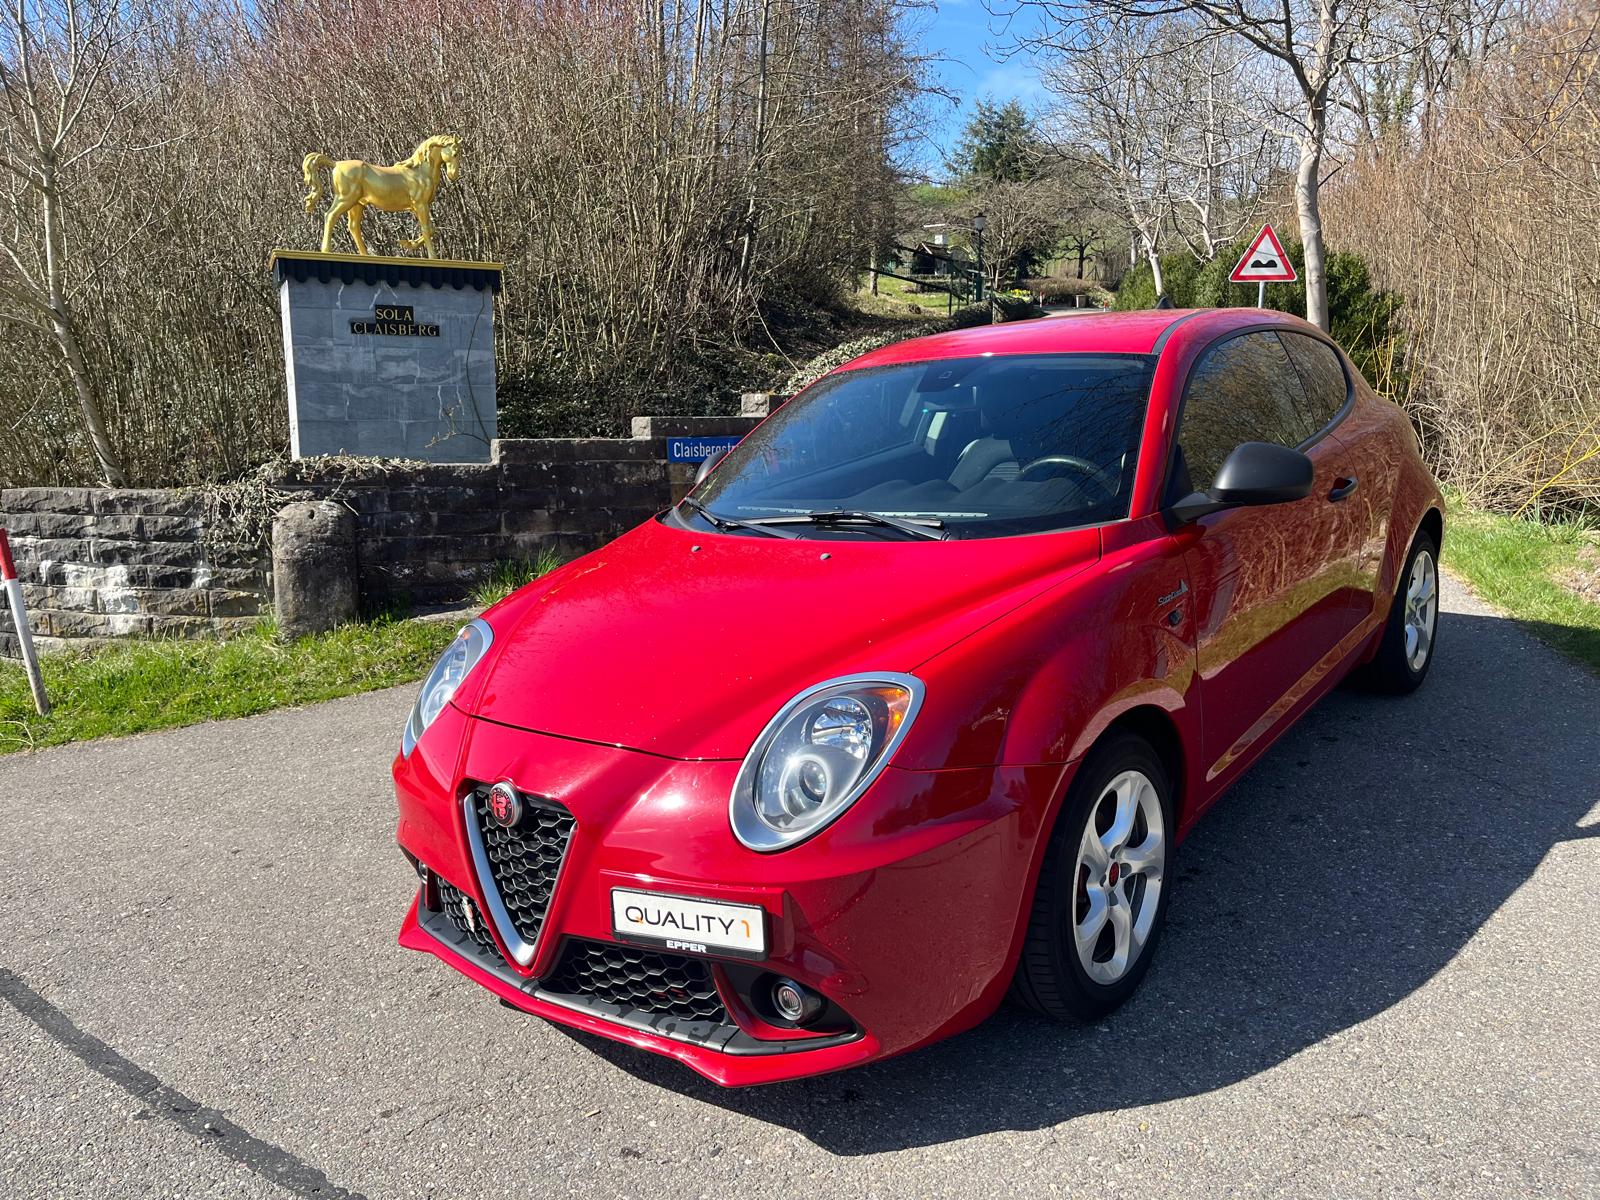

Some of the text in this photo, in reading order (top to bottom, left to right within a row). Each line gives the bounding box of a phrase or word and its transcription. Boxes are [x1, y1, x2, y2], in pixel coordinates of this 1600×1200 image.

[375, 308, 413, 321] SOLA
[353, 322, 437, 337] CLAISBERG
[665, 939, 708, 954] EPPER
